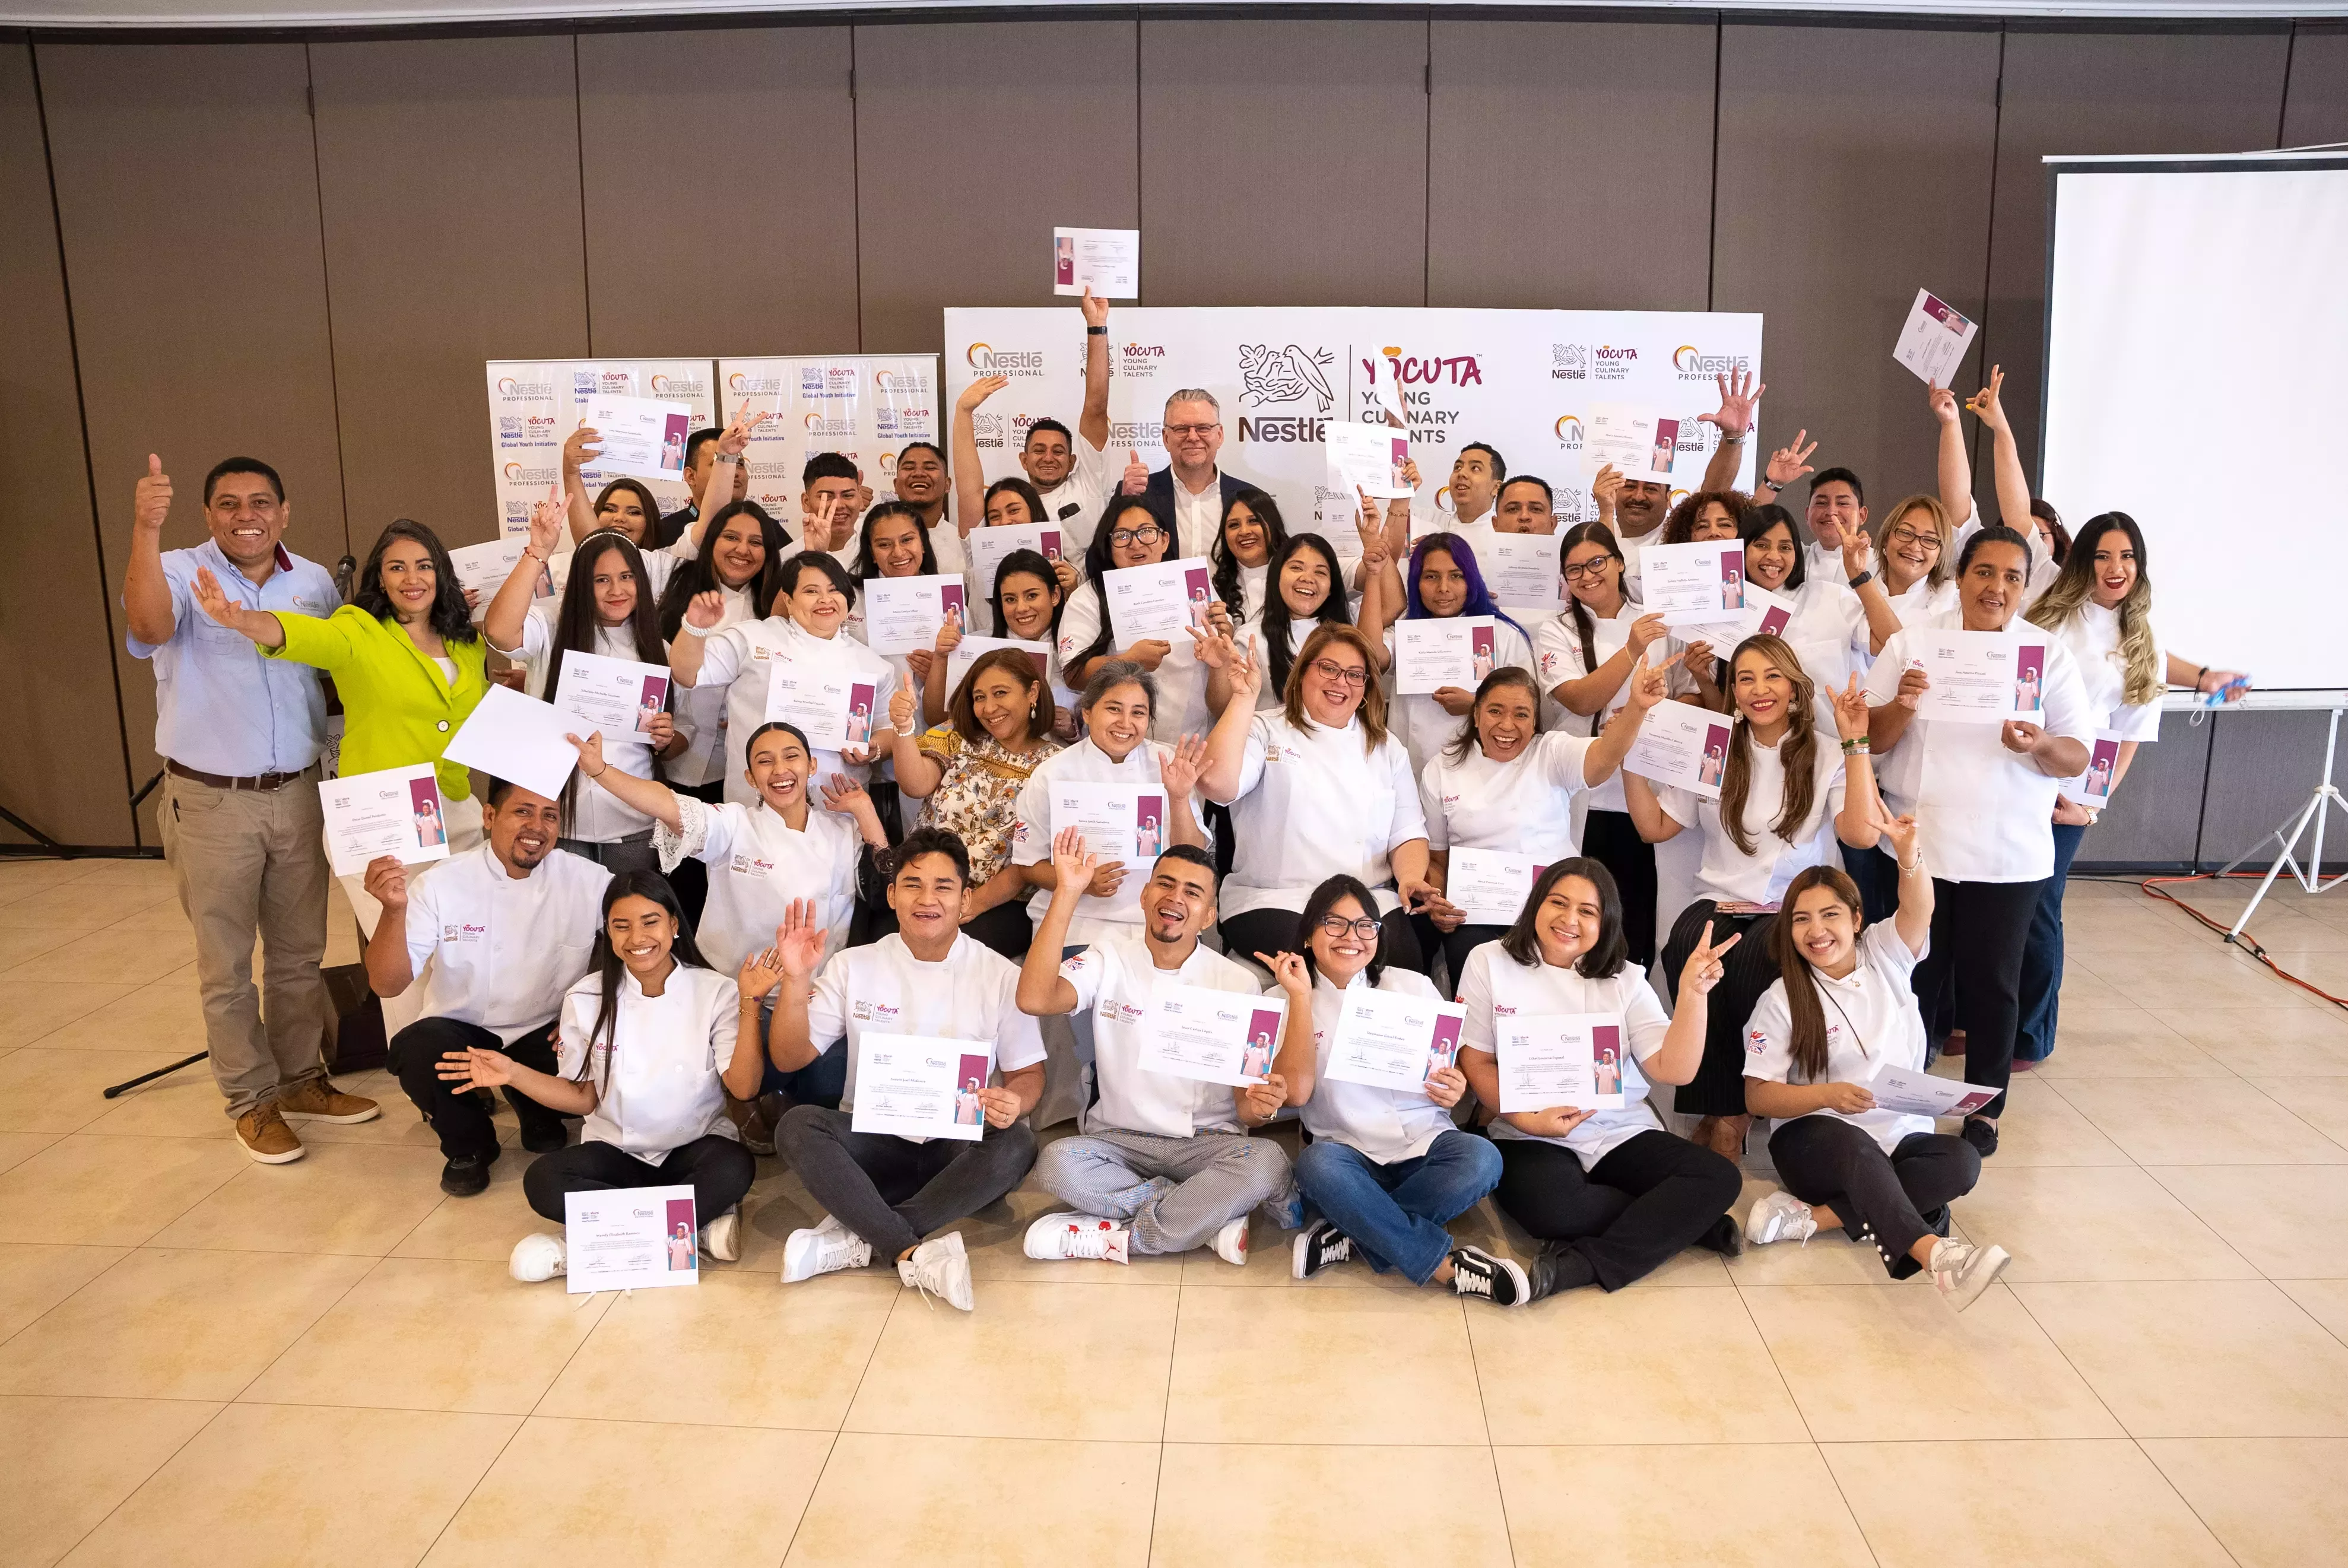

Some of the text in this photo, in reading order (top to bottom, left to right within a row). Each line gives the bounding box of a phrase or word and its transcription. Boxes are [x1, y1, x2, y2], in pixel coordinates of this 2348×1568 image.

[1123, 346, 1165, 357] YOCUTA
[1596, 349, 1638, 360] YOCUTA
[983, 351, 1042, 369] Nestlé
[1689, 356, 1749, 372] Nestlé
[1551, 369, 1586, 379] Nestlé
[510, 383, 552, 395] Nestlé
[662, 380, 703, 392] Nestlé
[740, 379, 780, 390] Nestlé
[1362, 392, 1430, 405] YNG
[1362, 411, 1459, 424] CUNARY
[816, 419, 856, 430] Nestlé
[516, 468, 557, 480] Nestlé
[1554, 513, 1581, 522] estlé
[1495, 1006, 1515, 1014] YOCUTA
